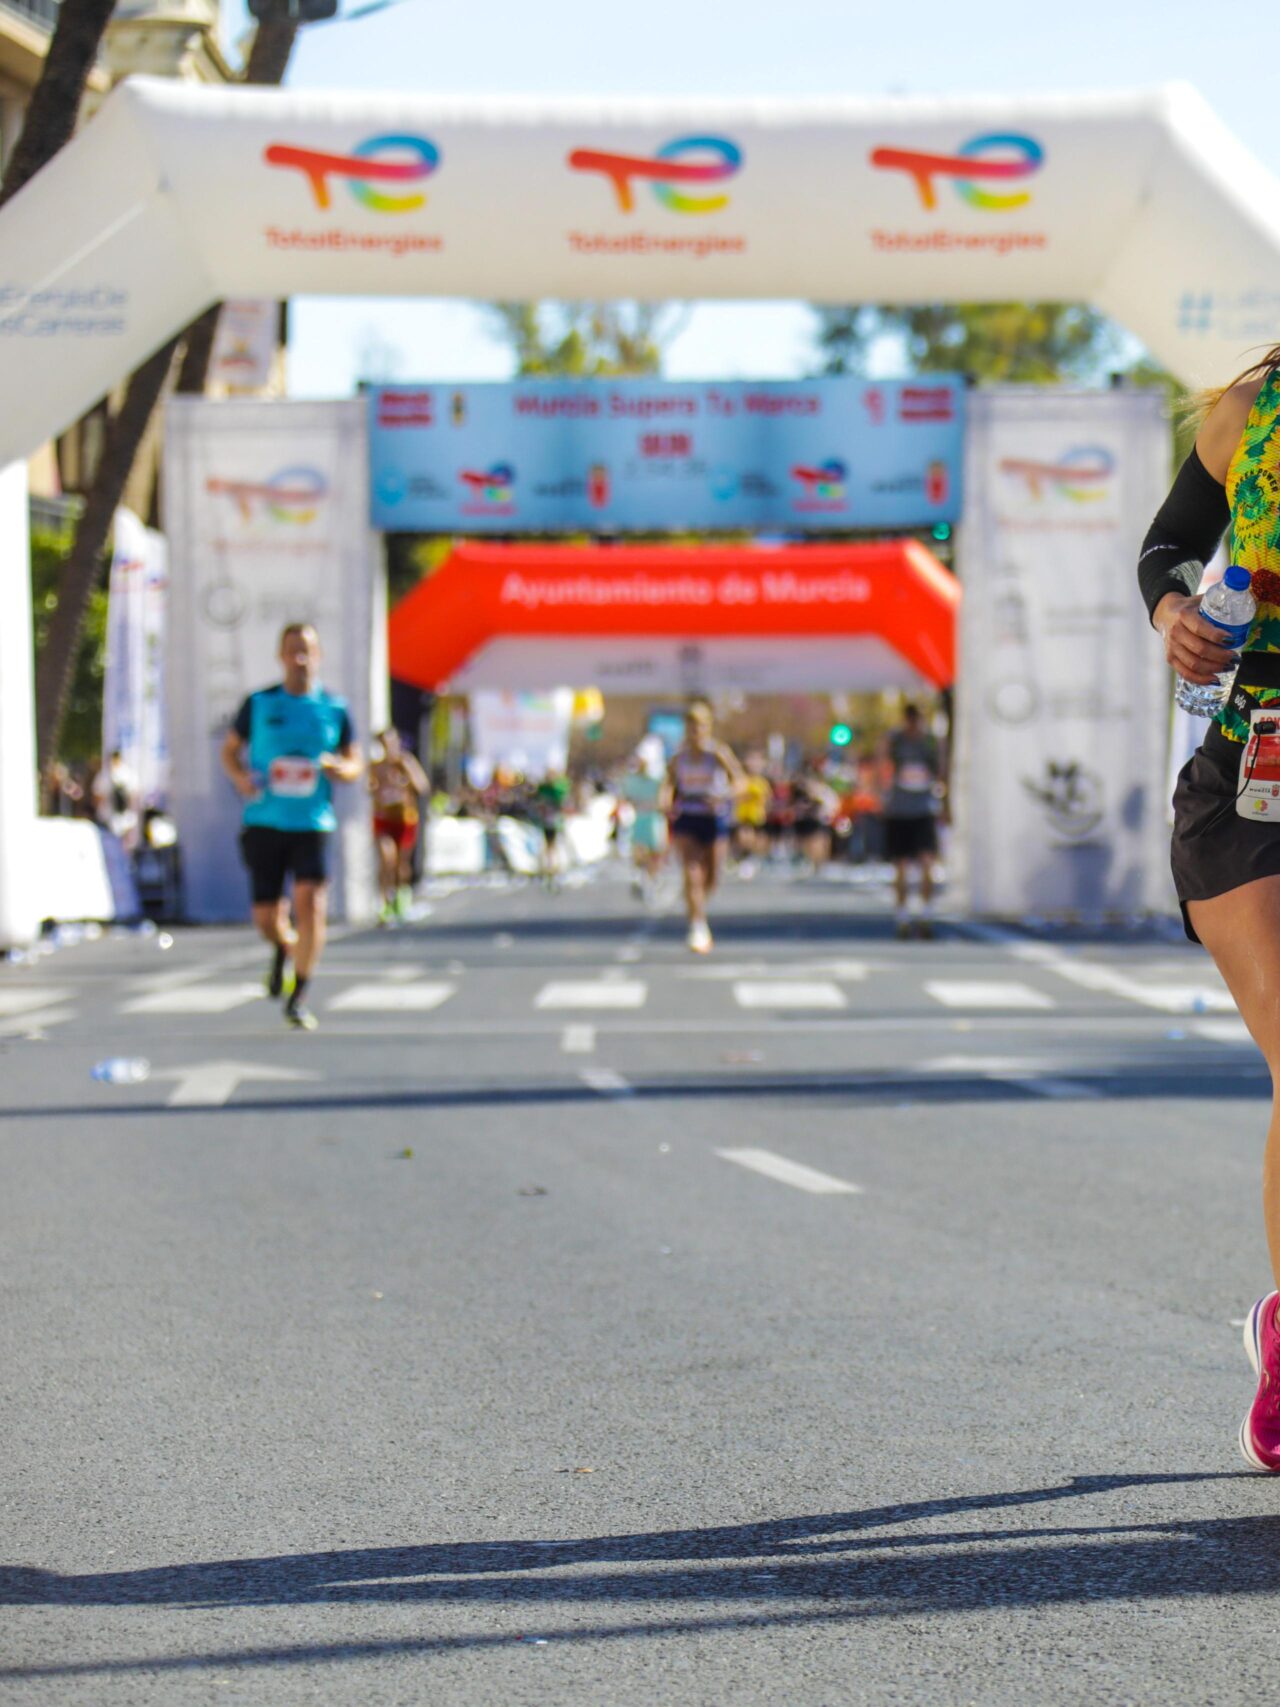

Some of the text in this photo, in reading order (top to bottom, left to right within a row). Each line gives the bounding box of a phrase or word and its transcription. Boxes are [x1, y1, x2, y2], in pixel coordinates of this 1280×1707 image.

[264, 228, 443, 257] TotalEnergies
[568, 231, 747, 259] TotalEnergies
[870, 229, 1048, 257] TotalEnergies
[503, 571, 870, 608] Ayuntamiento de Murcia
